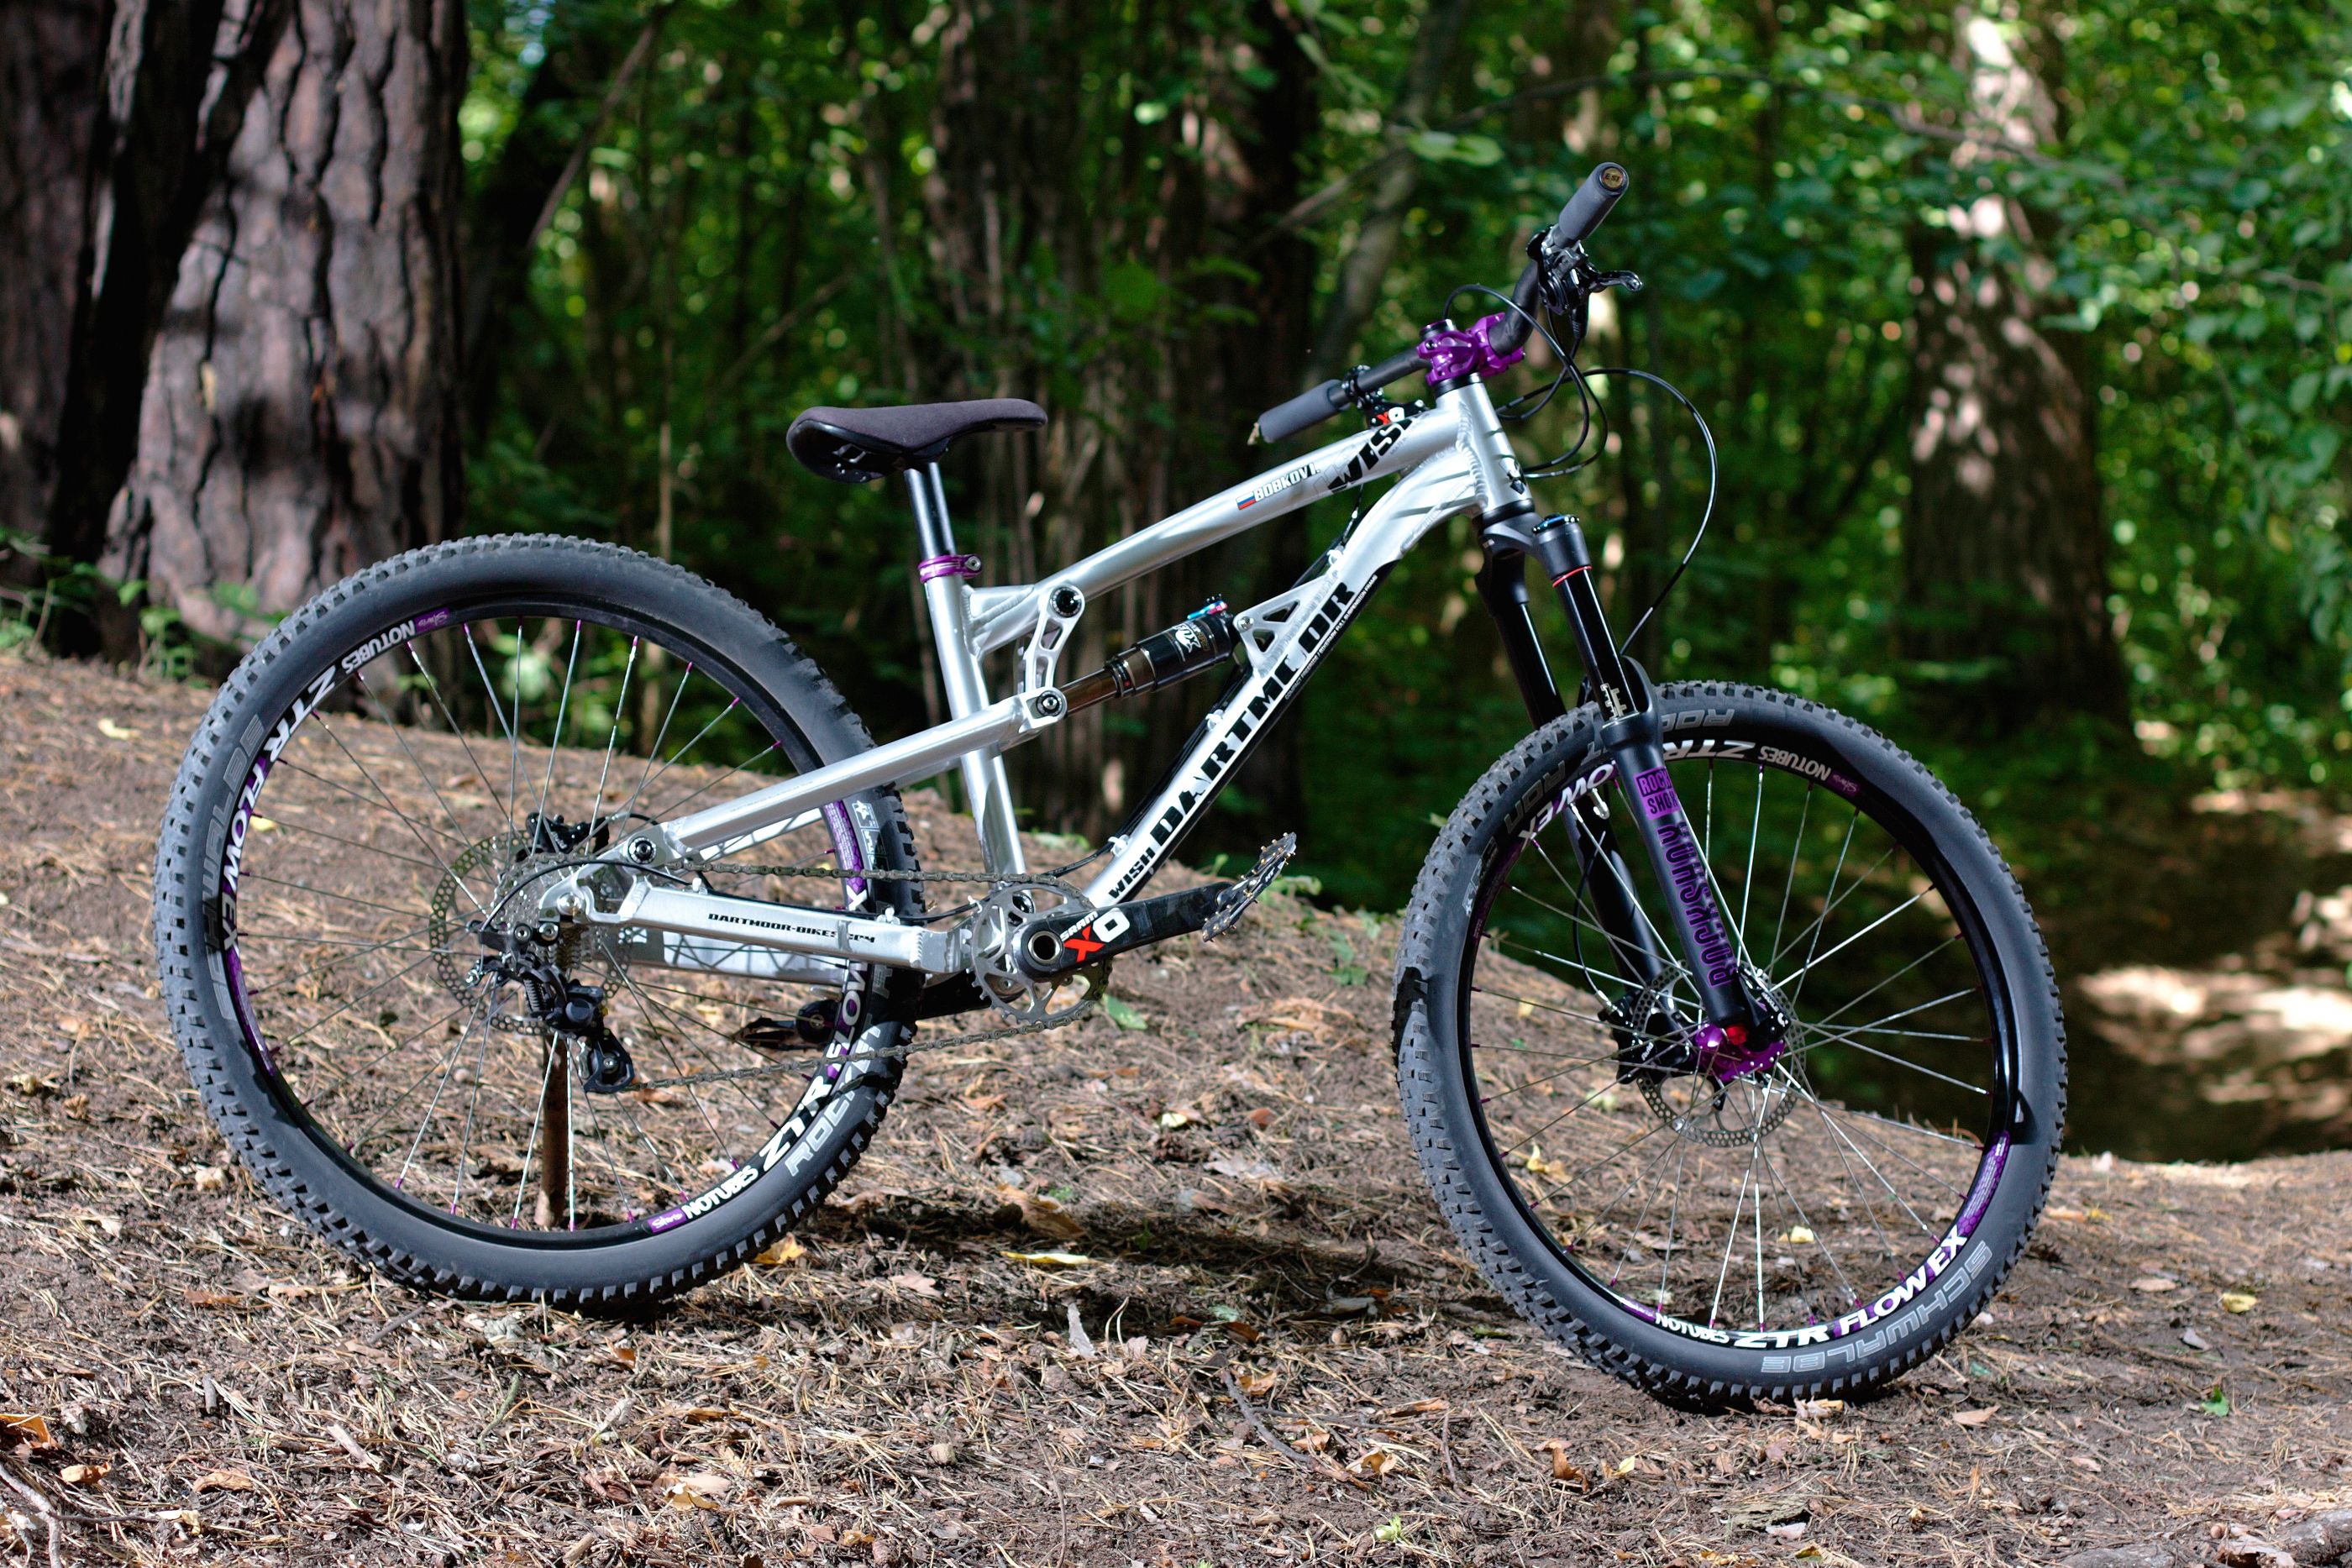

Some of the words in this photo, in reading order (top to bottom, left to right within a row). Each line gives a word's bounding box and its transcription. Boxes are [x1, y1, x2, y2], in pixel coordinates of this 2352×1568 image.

[341, 620, 417, 674] NOTUBES
[1285, 678, 1303, 700] COMPACT
[1343, 590, 1368, 620] SUSPENSION
[1366, 574, 1378, 593] FRAME
[263, 664, 336, 763] ZTR
[1662, 739, 1756, 761] ZTR
[1757, 745, 1832, 781] NOTUBES
[1556, 760, 1615, 815] OW
[1639, 769, 1672, 795] ROCK
[1647, 792, 1678, 814] SHOX
[223, 763, 265, 891] FLOW
[1518, 800, 1555, 853] EX
[202, 714, 265, 1020] SCHWALBE
[1108, 847, 1156, 899] WISH
[221, 892, 241, 957] EX
[1059, 910, 1099, 941] SRAM
[1656, 820, 1740, 989] ROCKSHOX
[681, 1165, 758, 1219] NOTUBES
[759, 1075, 832, 1172] ZTR
[1655, 1312, 1730, 1344] NOTUBES
[1734, 1324, 1830, 1349] ZTR
[1836, 1272, 1928, 1337] FLOW
[1929, 1225, 1968, 1277] EX
[1761, 1240, 1993, 1374] SCHWALBE
